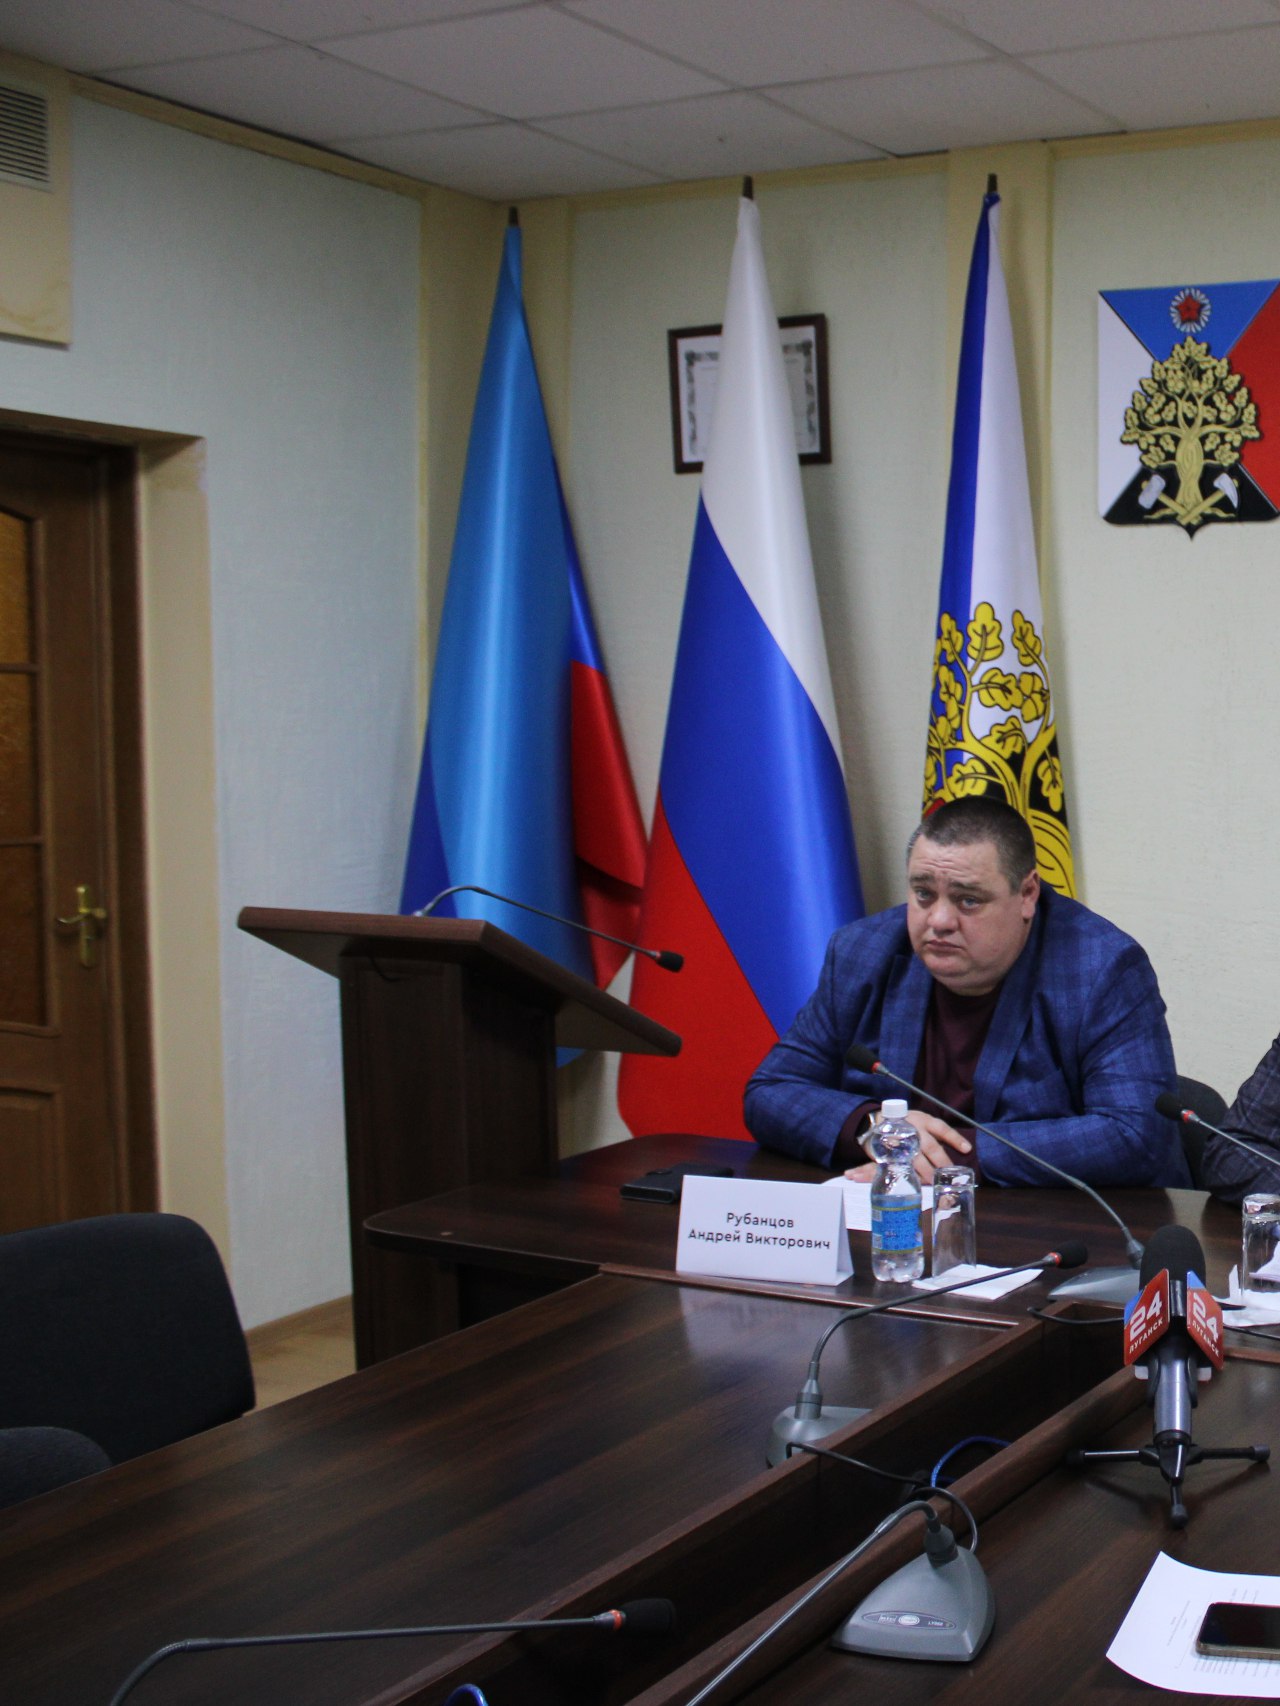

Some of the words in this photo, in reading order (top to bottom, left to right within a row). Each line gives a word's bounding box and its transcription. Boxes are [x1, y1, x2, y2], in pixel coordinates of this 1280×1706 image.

[687, 1229, 741, 1244] Андрей
[746, 1232, 831, 1250] Викторович
[726, 1212, 795, 1229] Рубанцов
[1129, 1290, 1163, 1342] 24
[1192, 1291, 1219, 1343] 24
[1128, 1317, 1164, 1355] ЛУГАНСК
[1192, 1319, 1220, 1358] ЛУГАНСК
